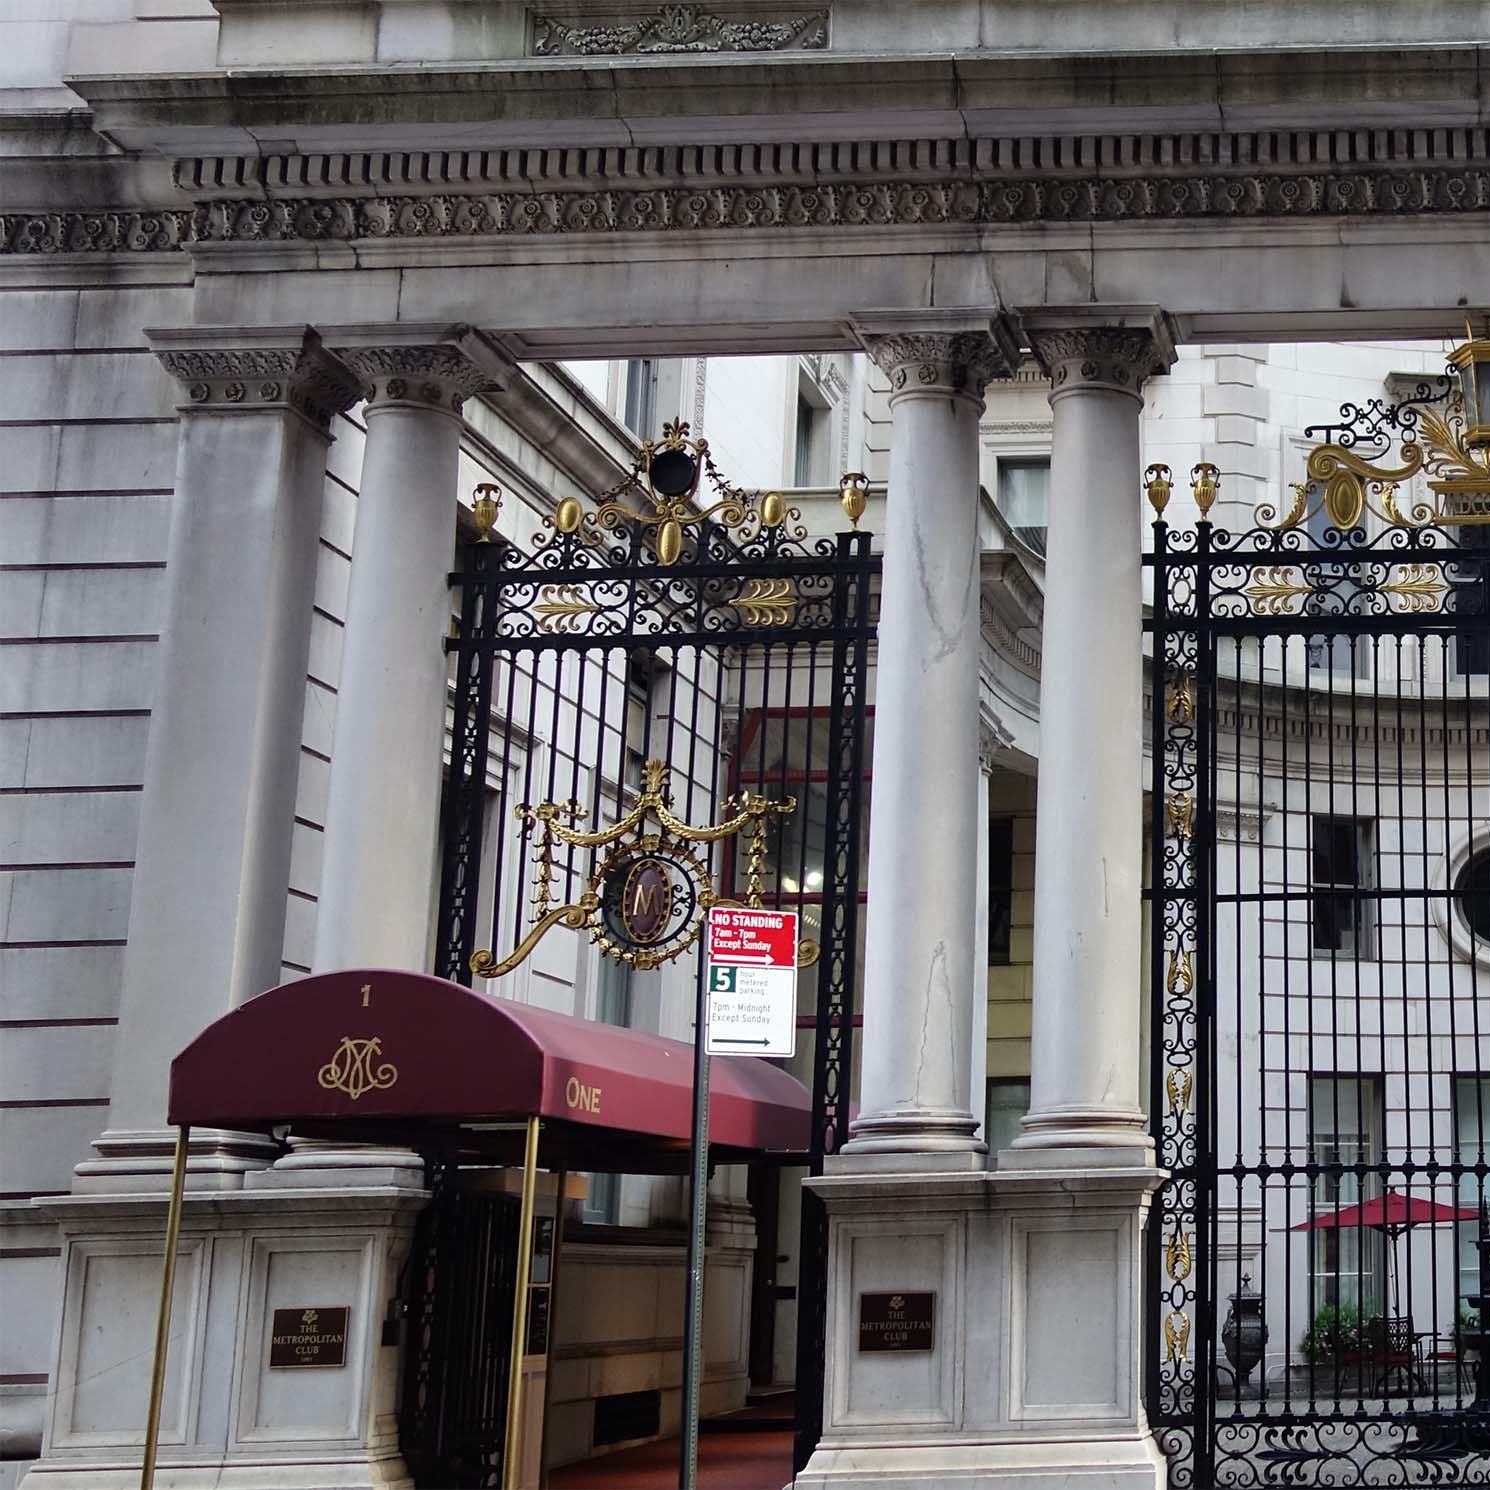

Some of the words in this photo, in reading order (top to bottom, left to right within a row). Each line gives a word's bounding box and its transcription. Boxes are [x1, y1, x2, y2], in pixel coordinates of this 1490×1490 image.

[632, 884, 661, 916] M
[714, 913, 730, 926] NO
[732, 915, 783, 929] STANDING
[715, 928, 732, 938] 7am
[739, 930, 756, 940] 7pm
[714, 938, 741, 950] Except
[743, 940, 772, 952] Sunday
[715, 967, 731, 991] 5
[740, 979, 768, 987] metered
[361, 984, 371, 1007] 1
[740, 987, 765, 996] parking
[712, 1002, 730, 1012] 7pm
[737, 1003, 771, 1015] Midnight
[711, 1013, 739, 1024] Except
[742, 1014, 771, 1025] Sunday
[887, 1310, 905, 1319] THE
[300, 1325, 319, 1333] THE
[861, 1321, 932, 1330] METROPOLITAN
[273, 1334, 343, 1345] METROPOLITAN
[884, 1332, 908, 1341] CLUB
[295, 1346, 319, 1354] CLUB
